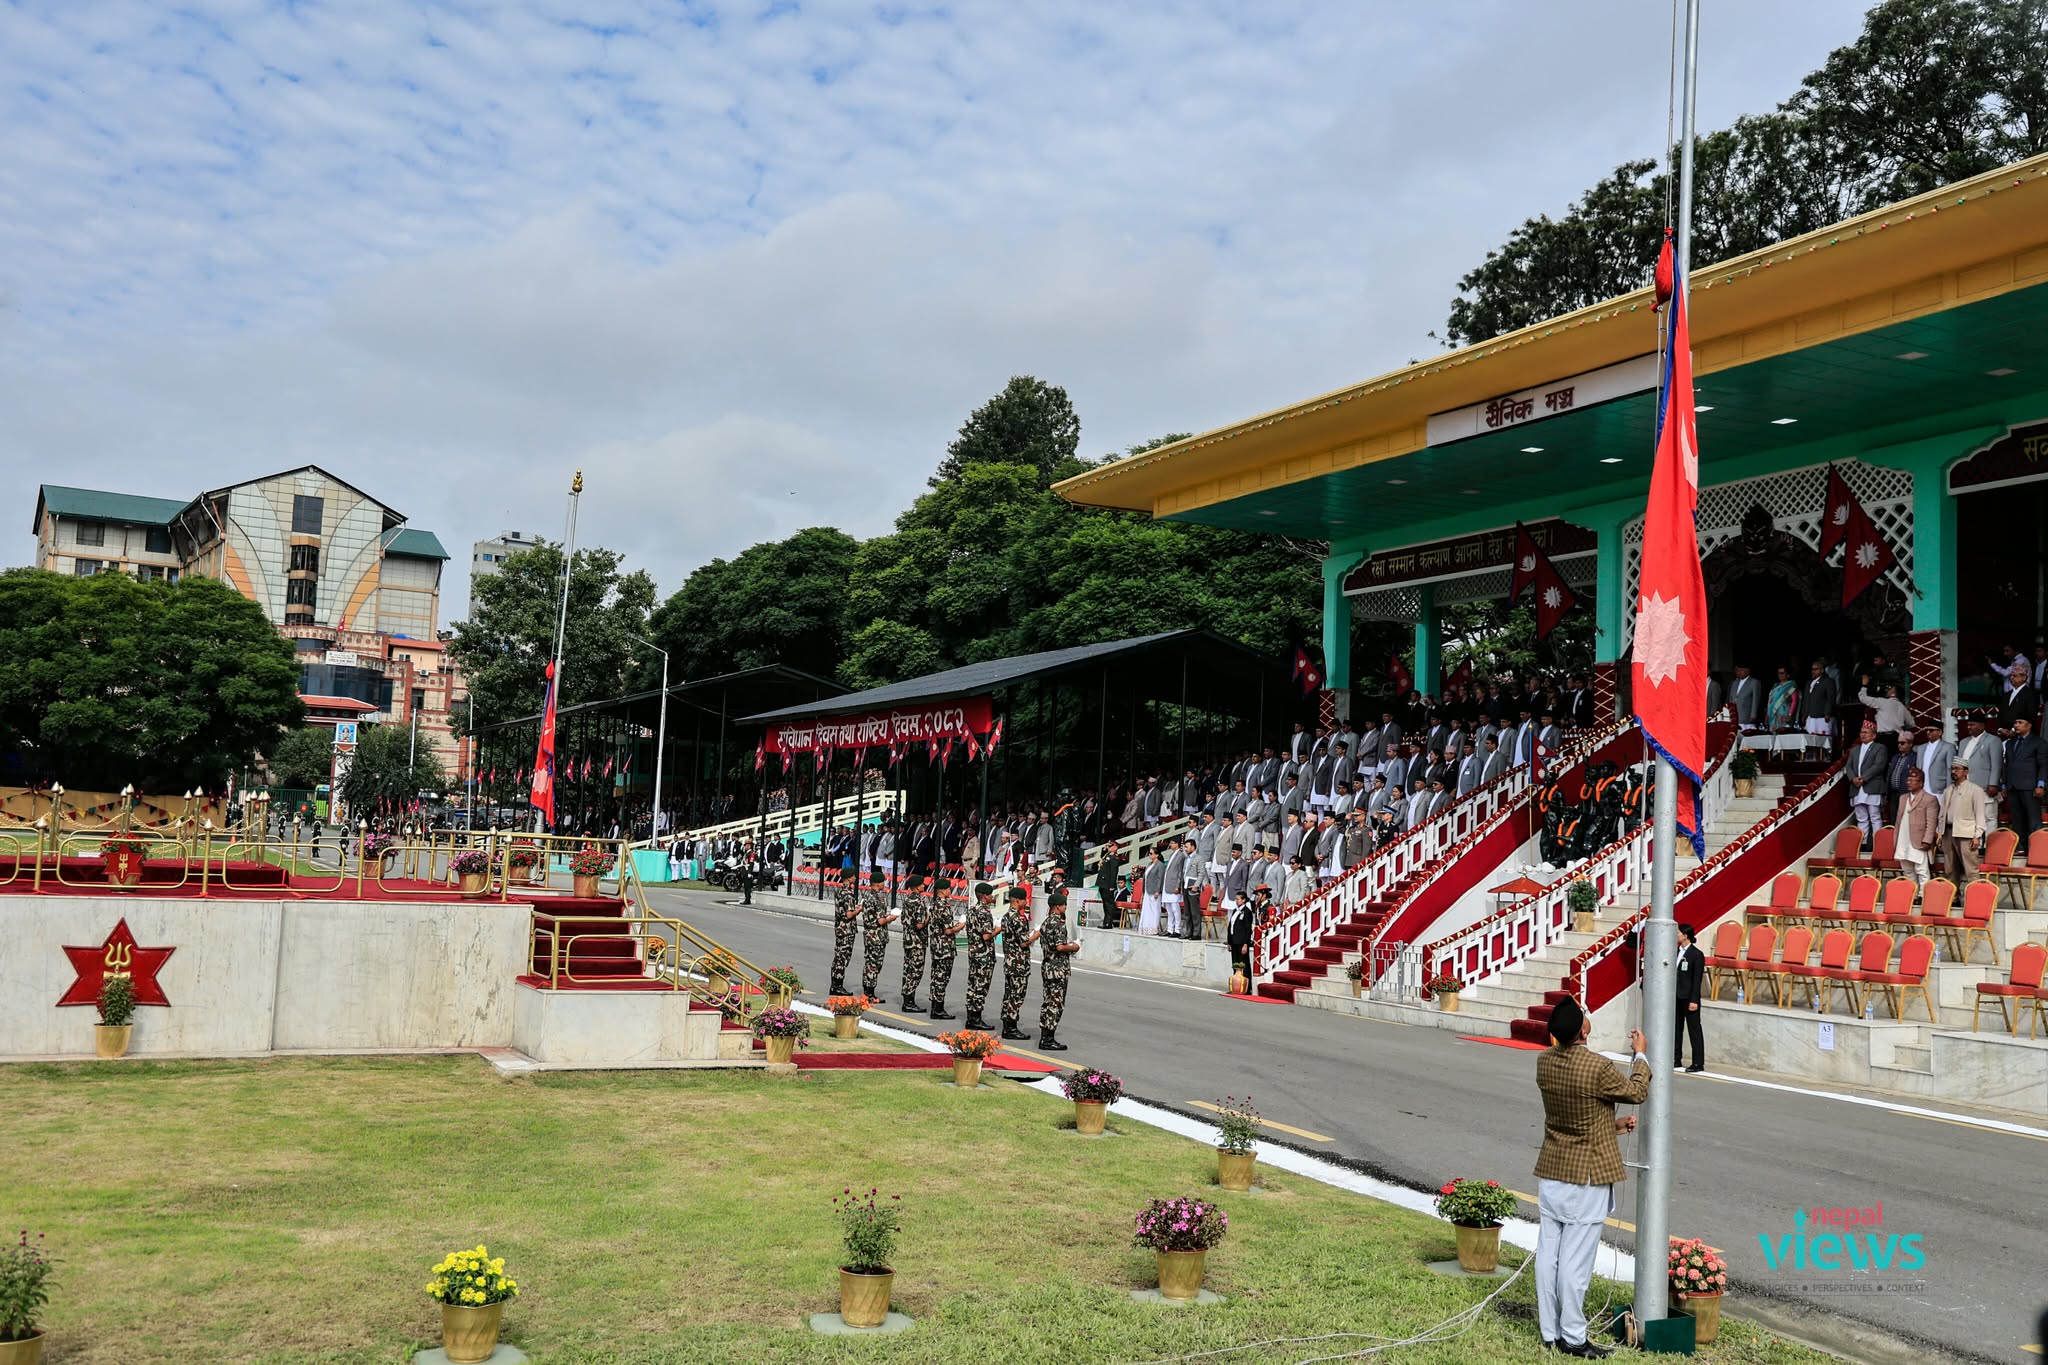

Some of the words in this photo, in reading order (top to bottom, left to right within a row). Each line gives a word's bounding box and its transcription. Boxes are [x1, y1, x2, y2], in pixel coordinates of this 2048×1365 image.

[1485, 398, 1534, 428] सैनिक
[1371, 559, 1386, 578] रक्षा
[1389, 554, 1415, 575] सम्मान
[1419, 547, 1451, 569] कल्याण
[778, 725, 814, 749] संविधान
[816, 722, 839, 746] दिवस
[839, 724, 856, 746] तथा
[857, 716, 888, 744] राष्ट्रिय
